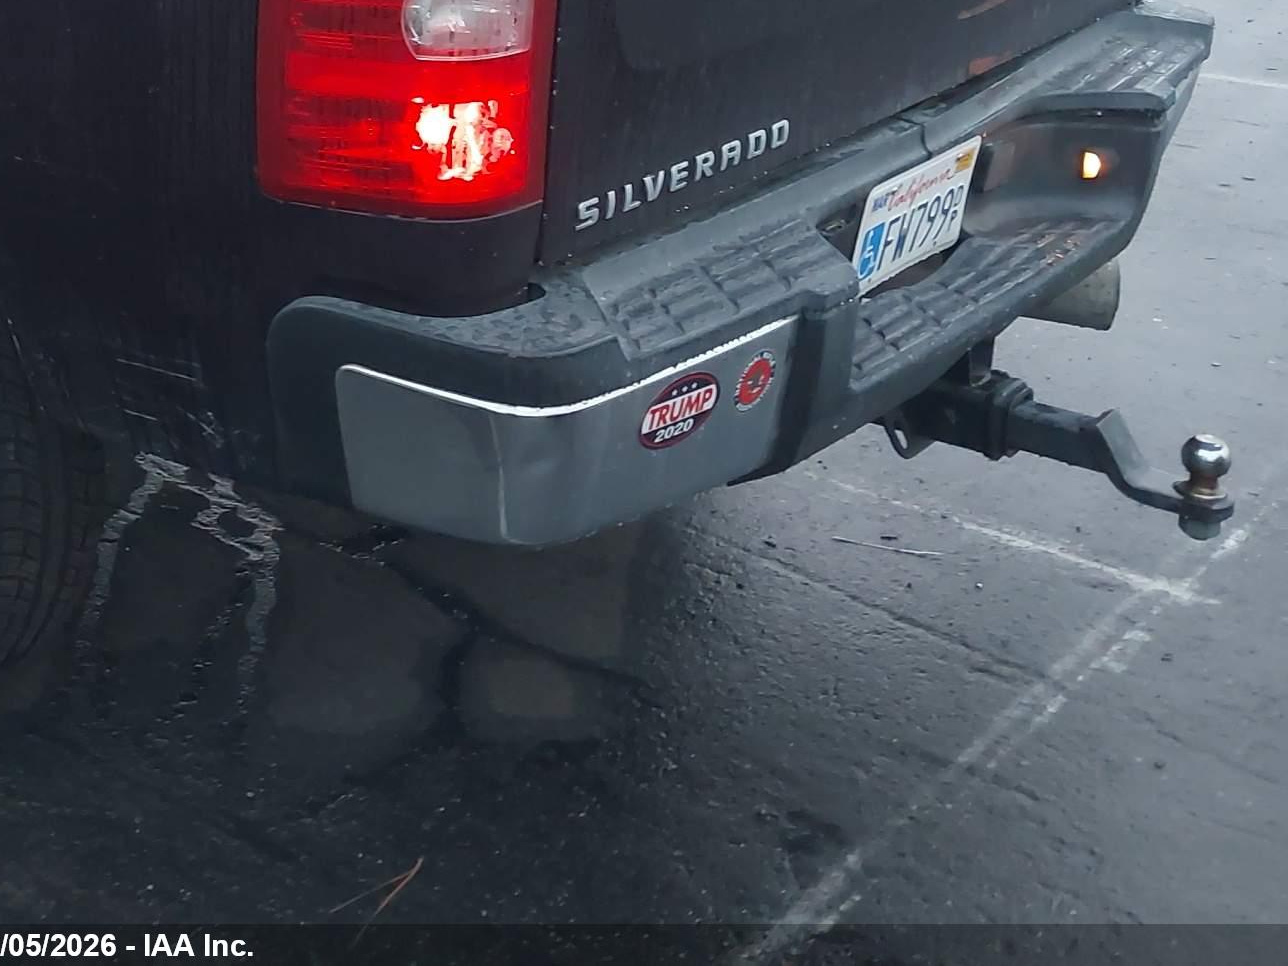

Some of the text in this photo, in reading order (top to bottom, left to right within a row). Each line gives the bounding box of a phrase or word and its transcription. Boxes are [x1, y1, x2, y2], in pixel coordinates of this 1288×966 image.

[574, 119, 790, 231] SILVERADO
[647, 387, 713, 431] TRUMP
[653, 418, 694, 444] 2020
